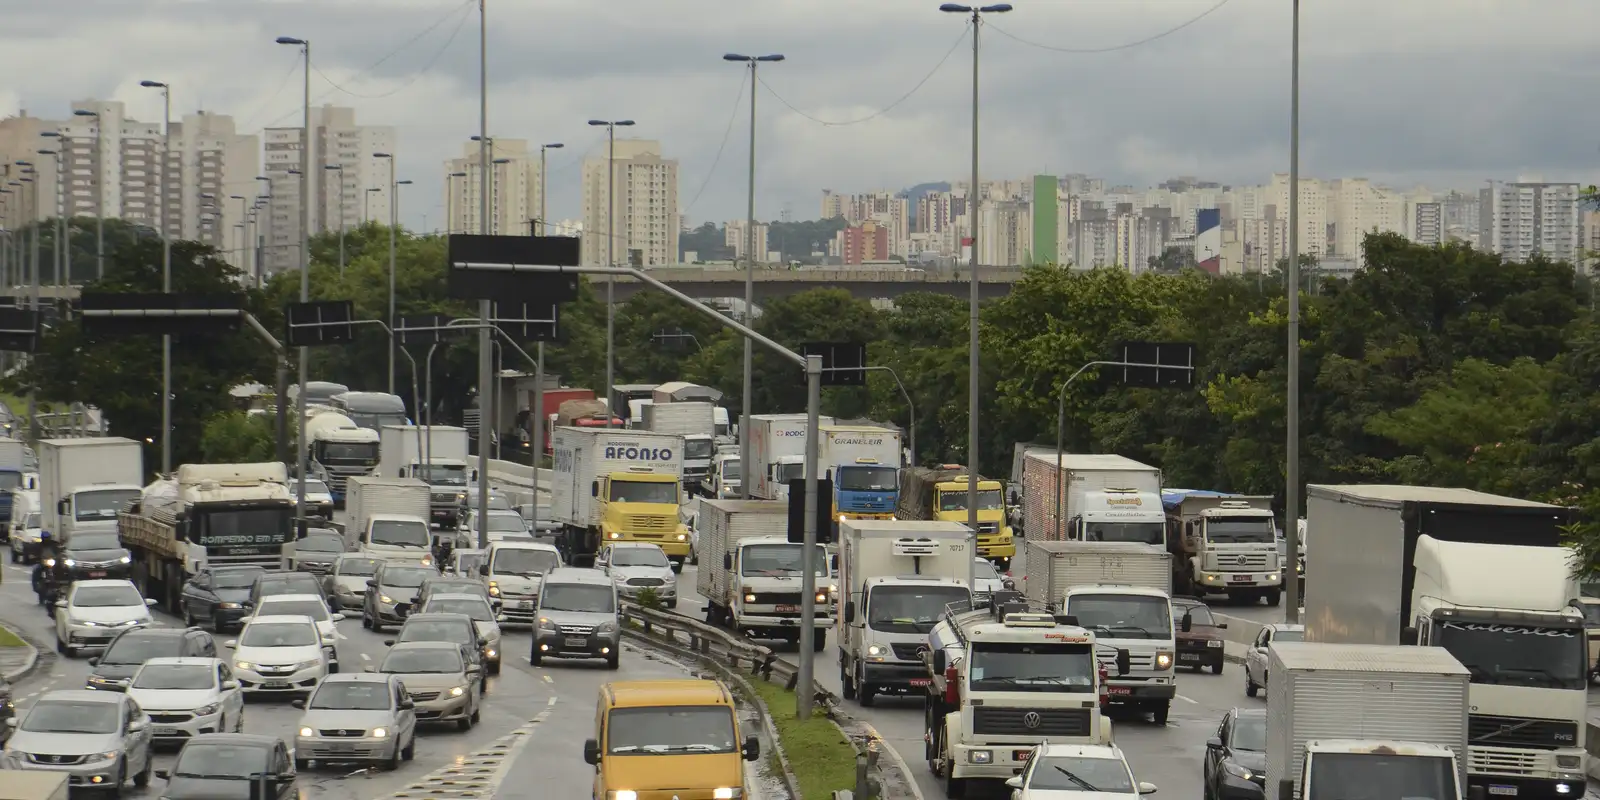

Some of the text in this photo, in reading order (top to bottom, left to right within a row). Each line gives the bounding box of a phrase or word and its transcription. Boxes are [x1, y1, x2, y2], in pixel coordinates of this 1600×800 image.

[605, 447, 673, 461] AFONSO
[200, 535, 254, 544] ROMPENDO
[255, 534, 271, 543] EM
